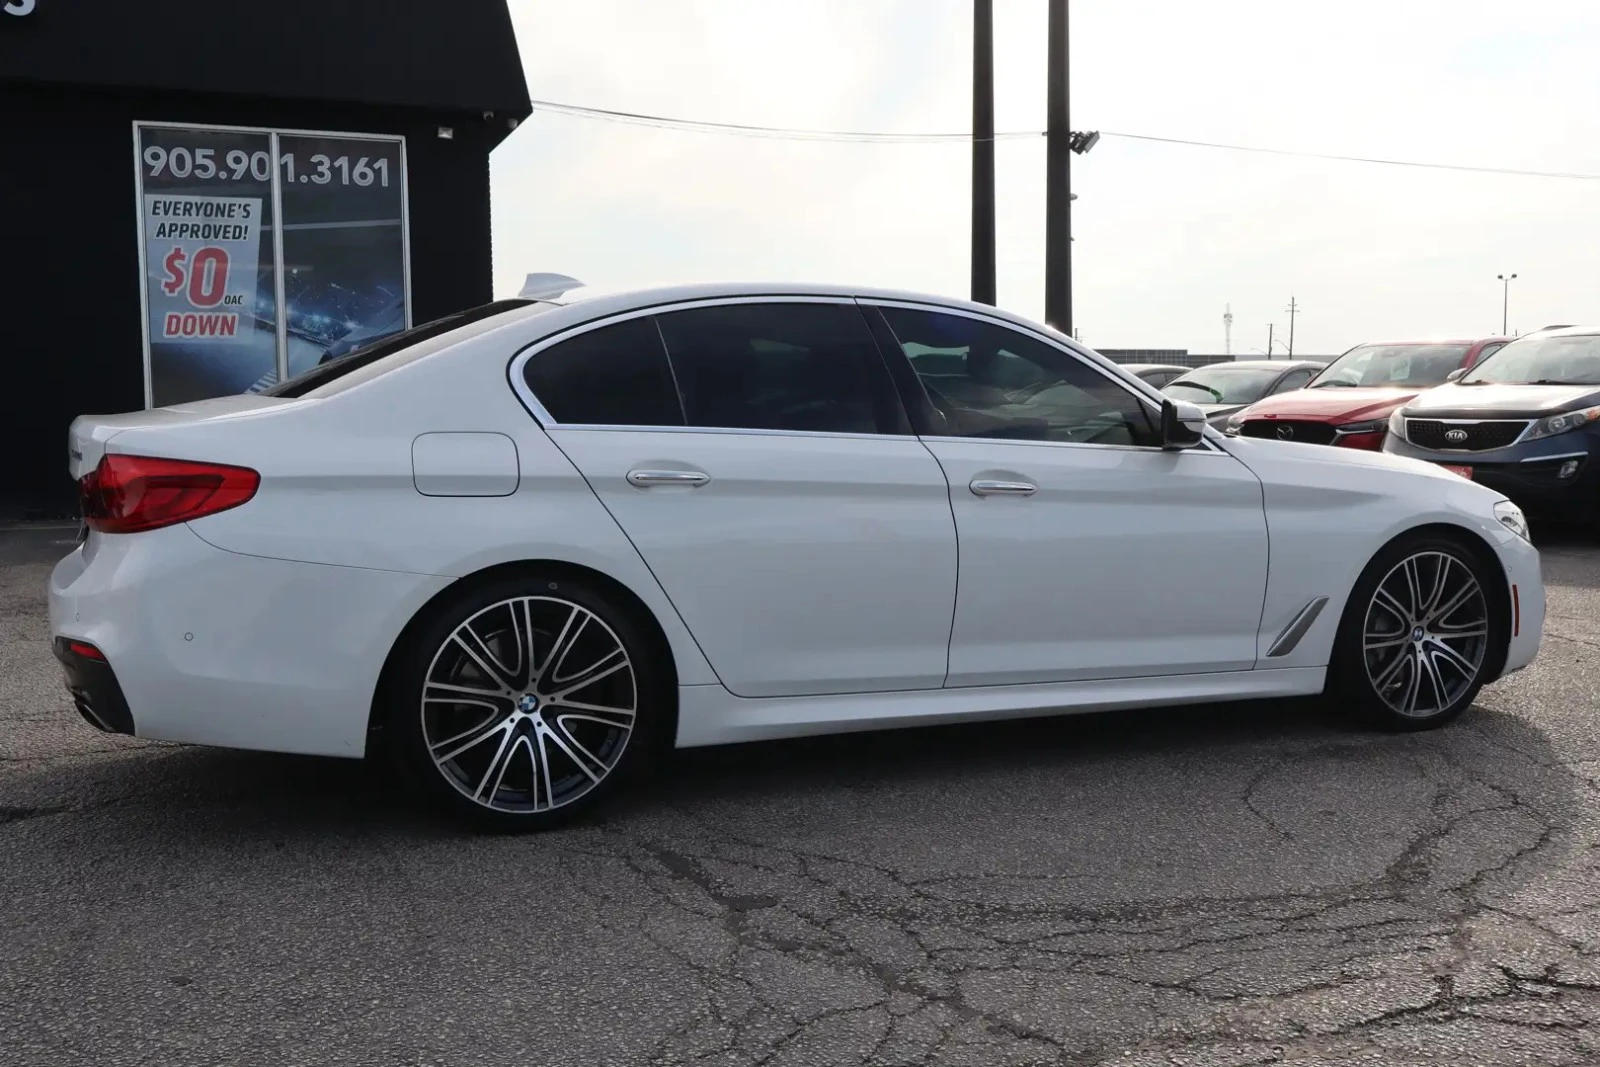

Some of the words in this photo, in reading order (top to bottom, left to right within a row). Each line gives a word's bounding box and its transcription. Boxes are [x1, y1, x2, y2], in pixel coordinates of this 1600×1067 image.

[144, 146, 388, 187] 905.901.3161
[151, 200, 251, 219] EVERYONE'S
[155, 222, 249, 240] APPROVED!
[163, 247, 229, 306] $0
[224, 294, 243, 306] OAC
[165, 313, 237, 336] DOWN
[1447, 431, 1464, 441] KIA
